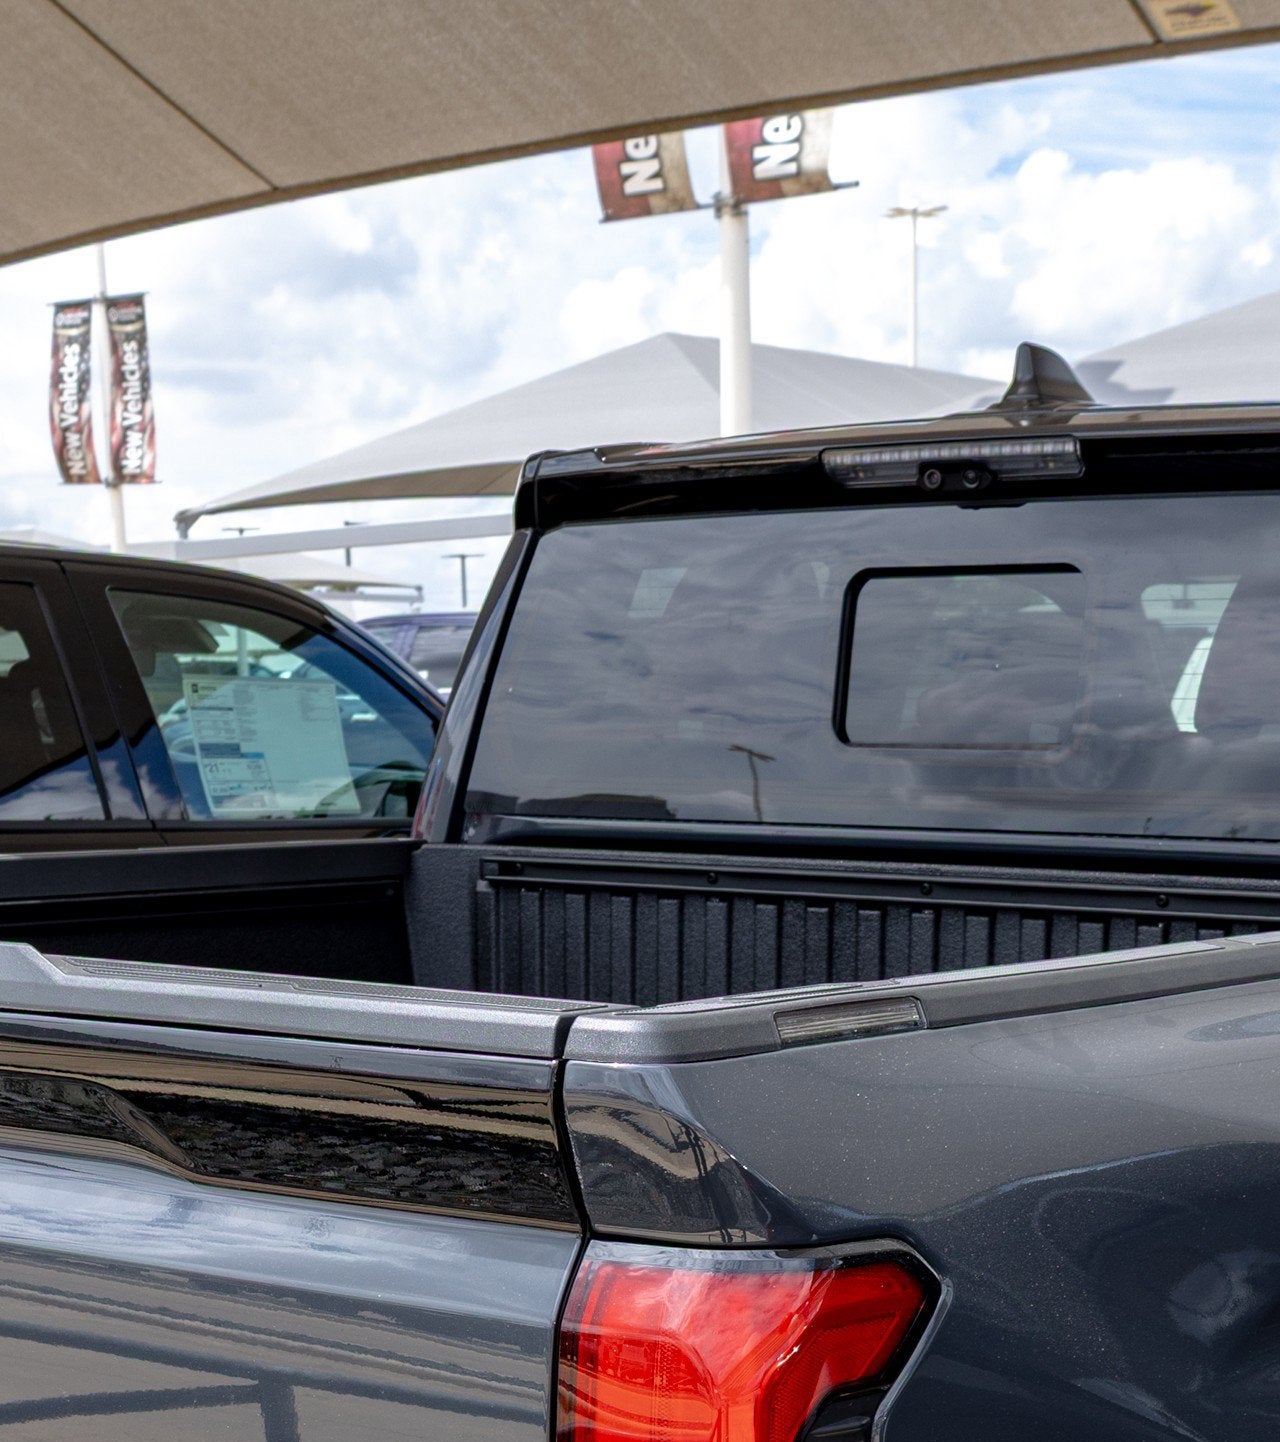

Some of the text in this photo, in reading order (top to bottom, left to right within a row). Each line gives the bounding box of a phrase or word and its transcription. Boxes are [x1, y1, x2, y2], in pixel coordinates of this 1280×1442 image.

[59, 342, 81, 428] Vehicles
[122, 341, 142, 427] Vehicles
[68, 433, 87, 476] New
[121, 431, 143, 475] New
